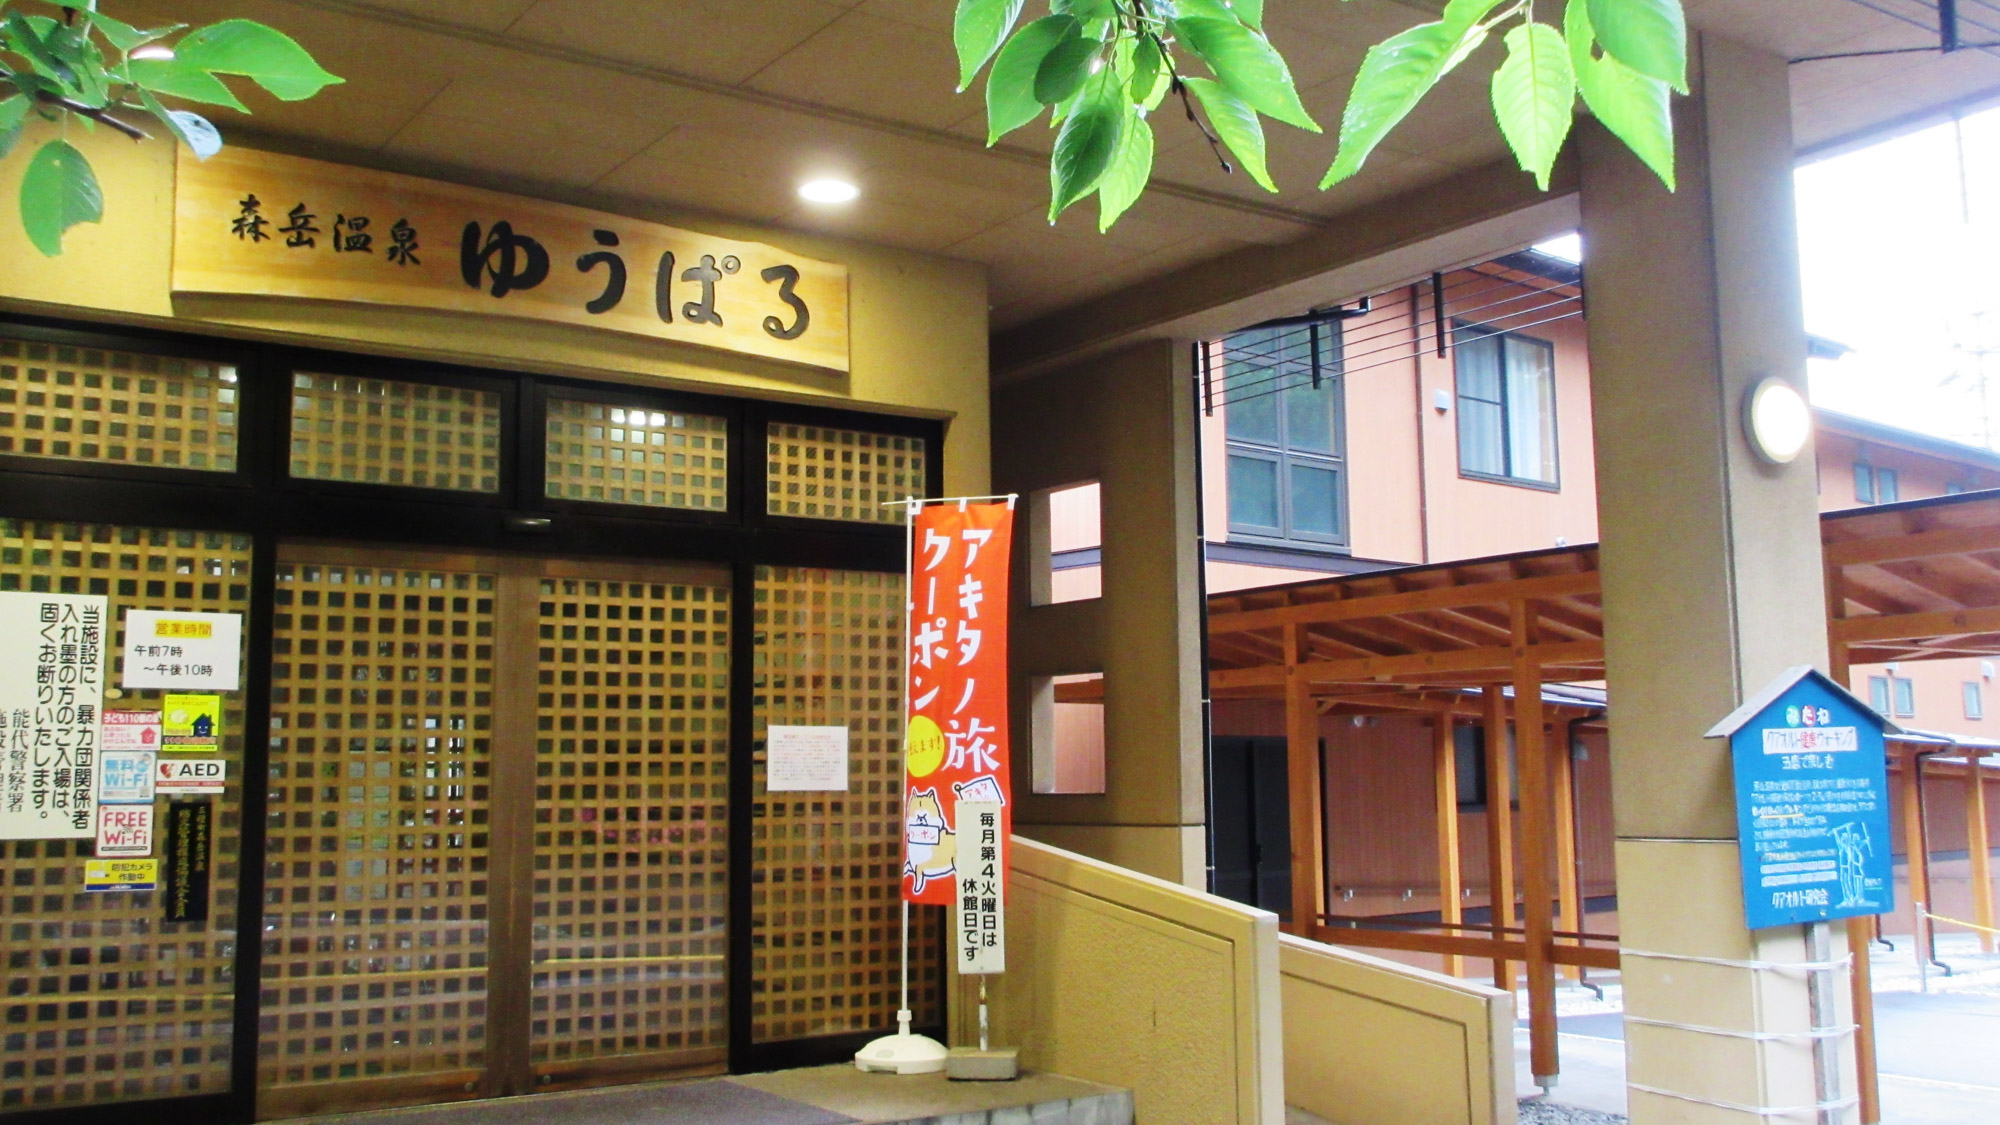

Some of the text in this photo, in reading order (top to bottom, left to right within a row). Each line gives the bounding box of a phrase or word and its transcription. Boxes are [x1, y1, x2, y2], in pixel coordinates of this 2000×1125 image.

[231, 193, 811, 341] 森岳温泉 ゆうぱる
[134, 645, 183, 658] 午前7時
[156, 623, 212, 636] 営業時間
[913, 527, 951, 709] クーポン
[942, 528, 1000, 773] アキタノ旅
[32, 602, 60, 819] 固くお断りいたします。
[52, 603, 80, 818] 入れ墨の方のご入場は、
[72, 604, 100, 830] 当施設に、暴力団関係者
[1786, 705, 1830, 726] みたね
[7, 708, 30, 813] 能代警察署
[105, 773, 148, 786] Wi-Fi
[179, 763, 220, 776] AED
[103, 829, 148, 845] Wi-Fi
[104, 812, 148, 827] FREE
[111, 863, 153, 872] 防犯カメラ
[980, 812, 997, 948] 毎月第4火曜日は
[962, 877, 979, 962] 休館日です
